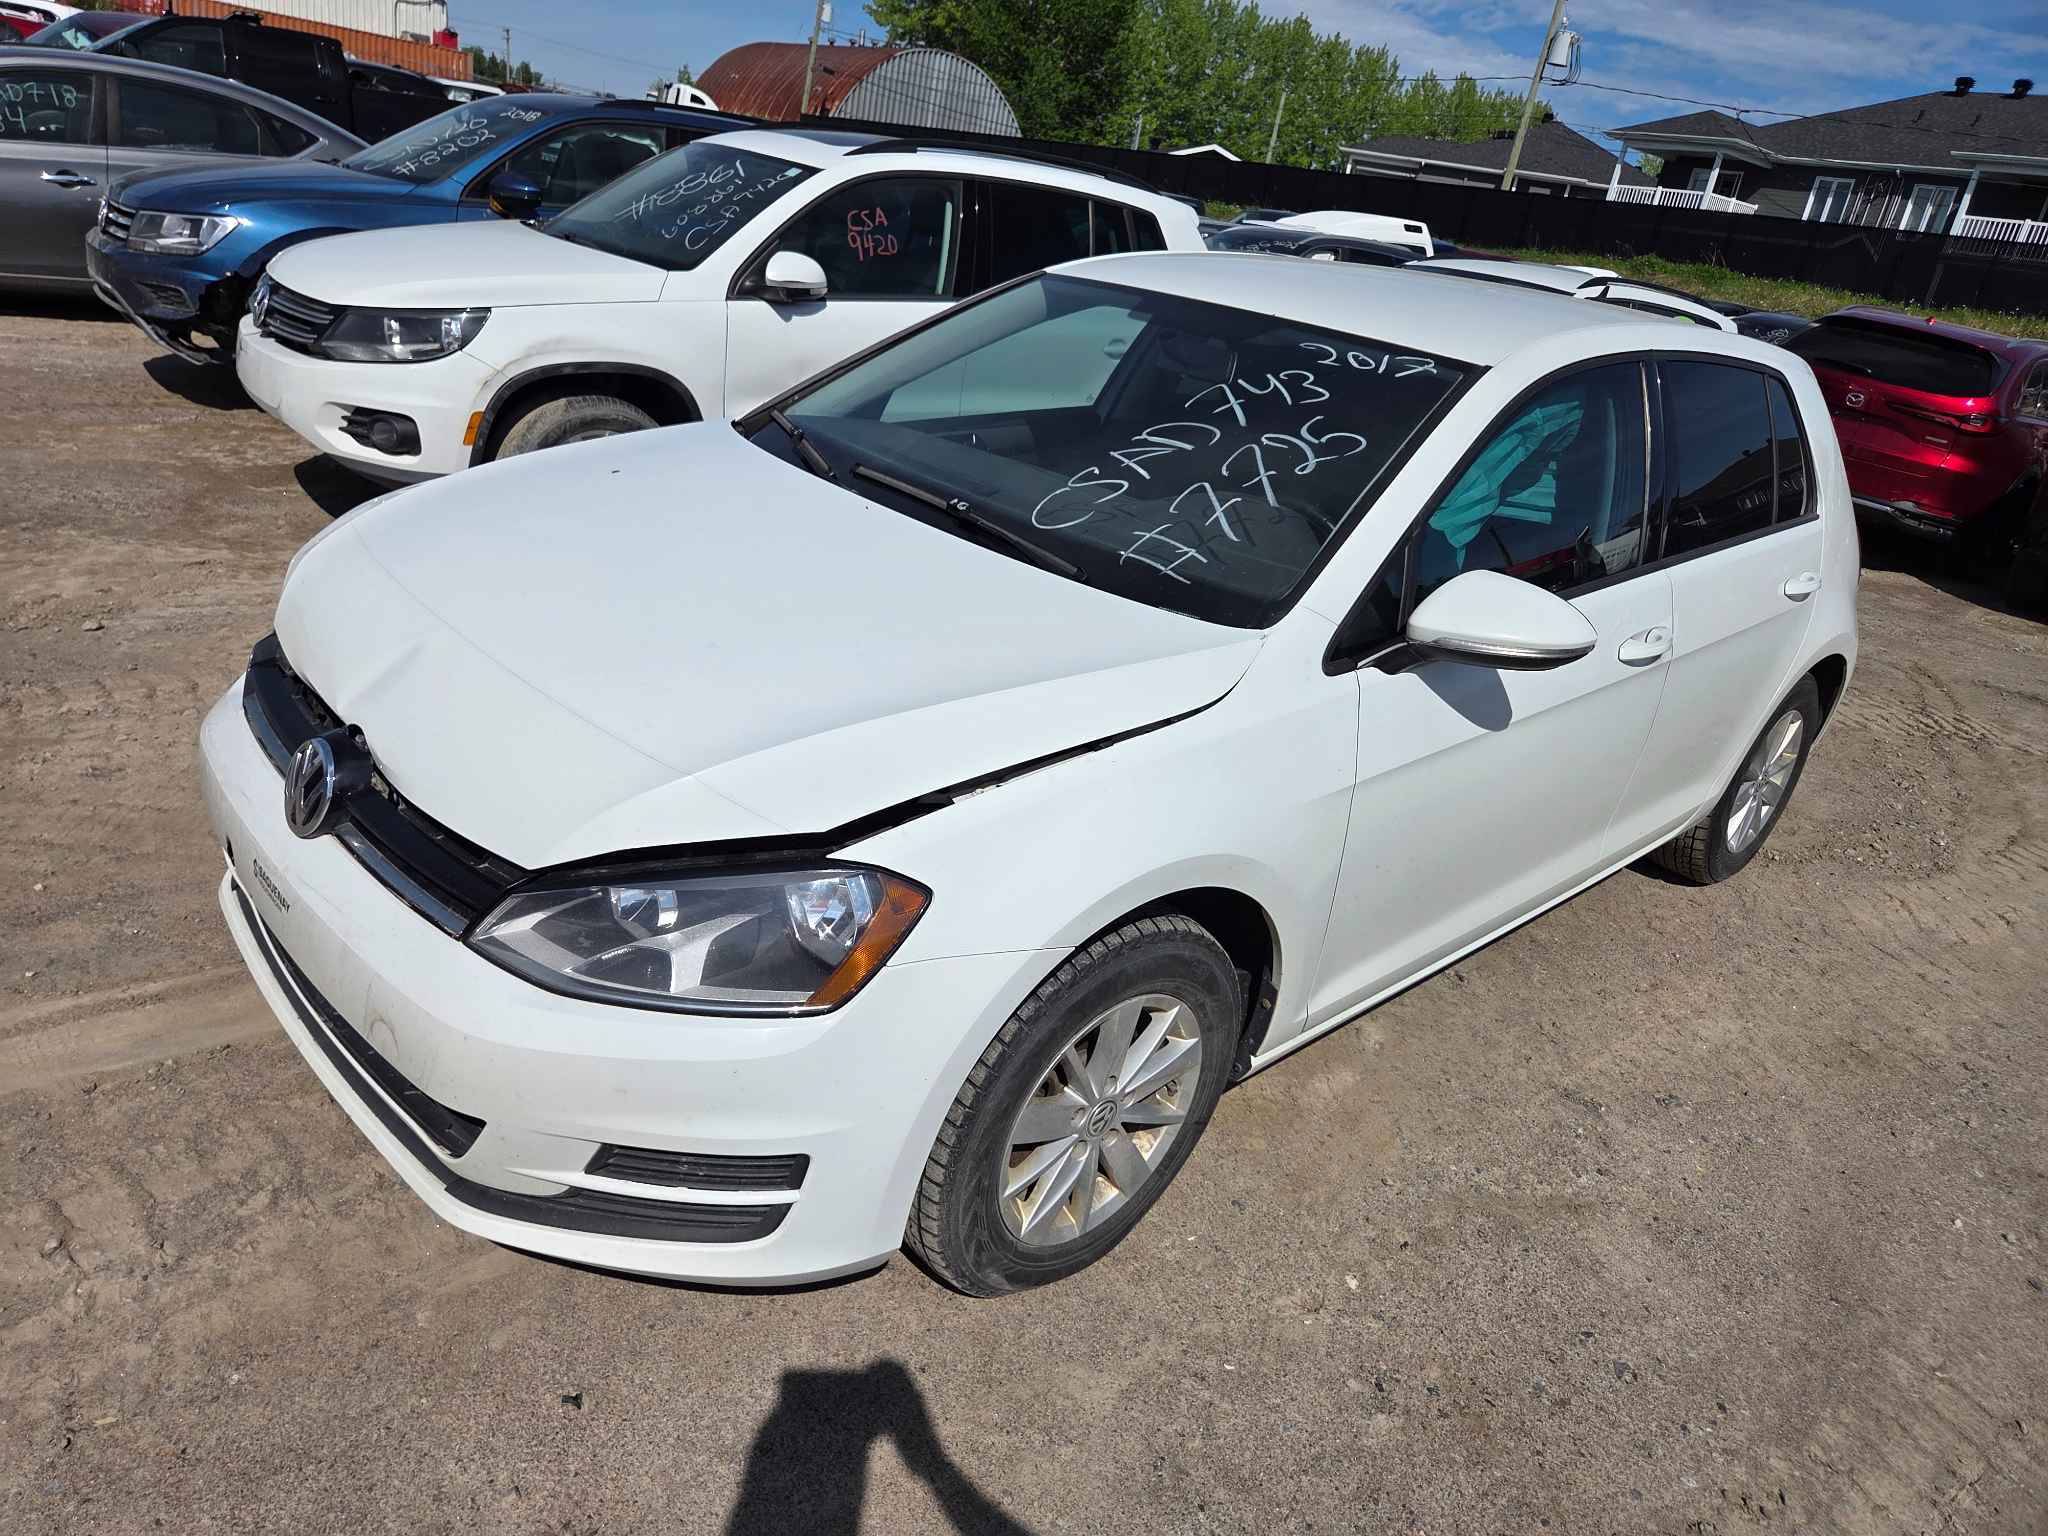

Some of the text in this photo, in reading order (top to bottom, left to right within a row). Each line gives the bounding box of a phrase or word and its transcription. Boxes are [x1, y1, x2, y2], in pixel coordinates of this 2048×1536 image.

[848, 207, 888, 231] CSA
[848, 231, 898, 262] 9420
[1299, 342, 1438, 378] 2017
[1119, 416, 1367, 584] #7725
